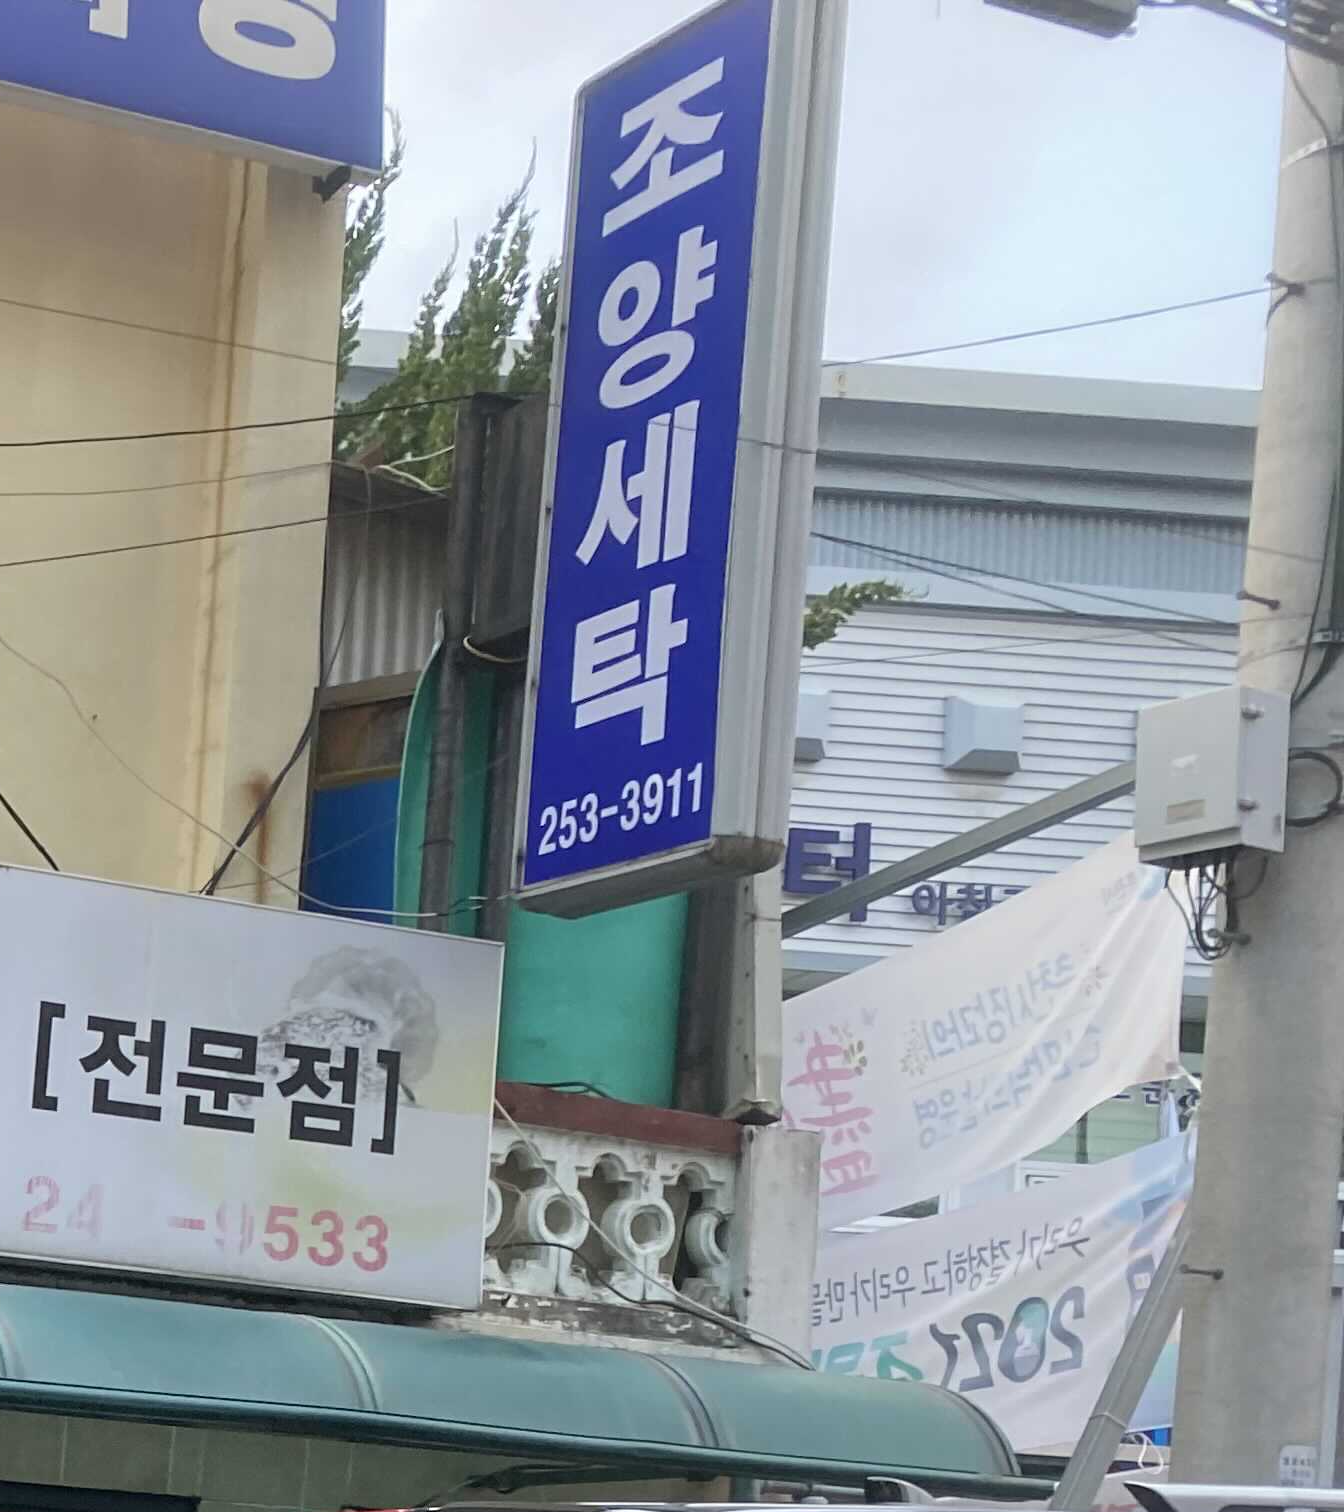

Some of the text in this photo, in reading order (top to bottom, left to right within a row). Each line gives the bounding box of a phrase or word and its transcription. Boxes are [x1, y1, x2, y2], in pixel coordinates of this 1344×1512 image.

[570, 57, 724, 746] 조양세탁
[539, 763, 704, 857] 253-3911
[32, 1001, 400, 1155] [전문점]
